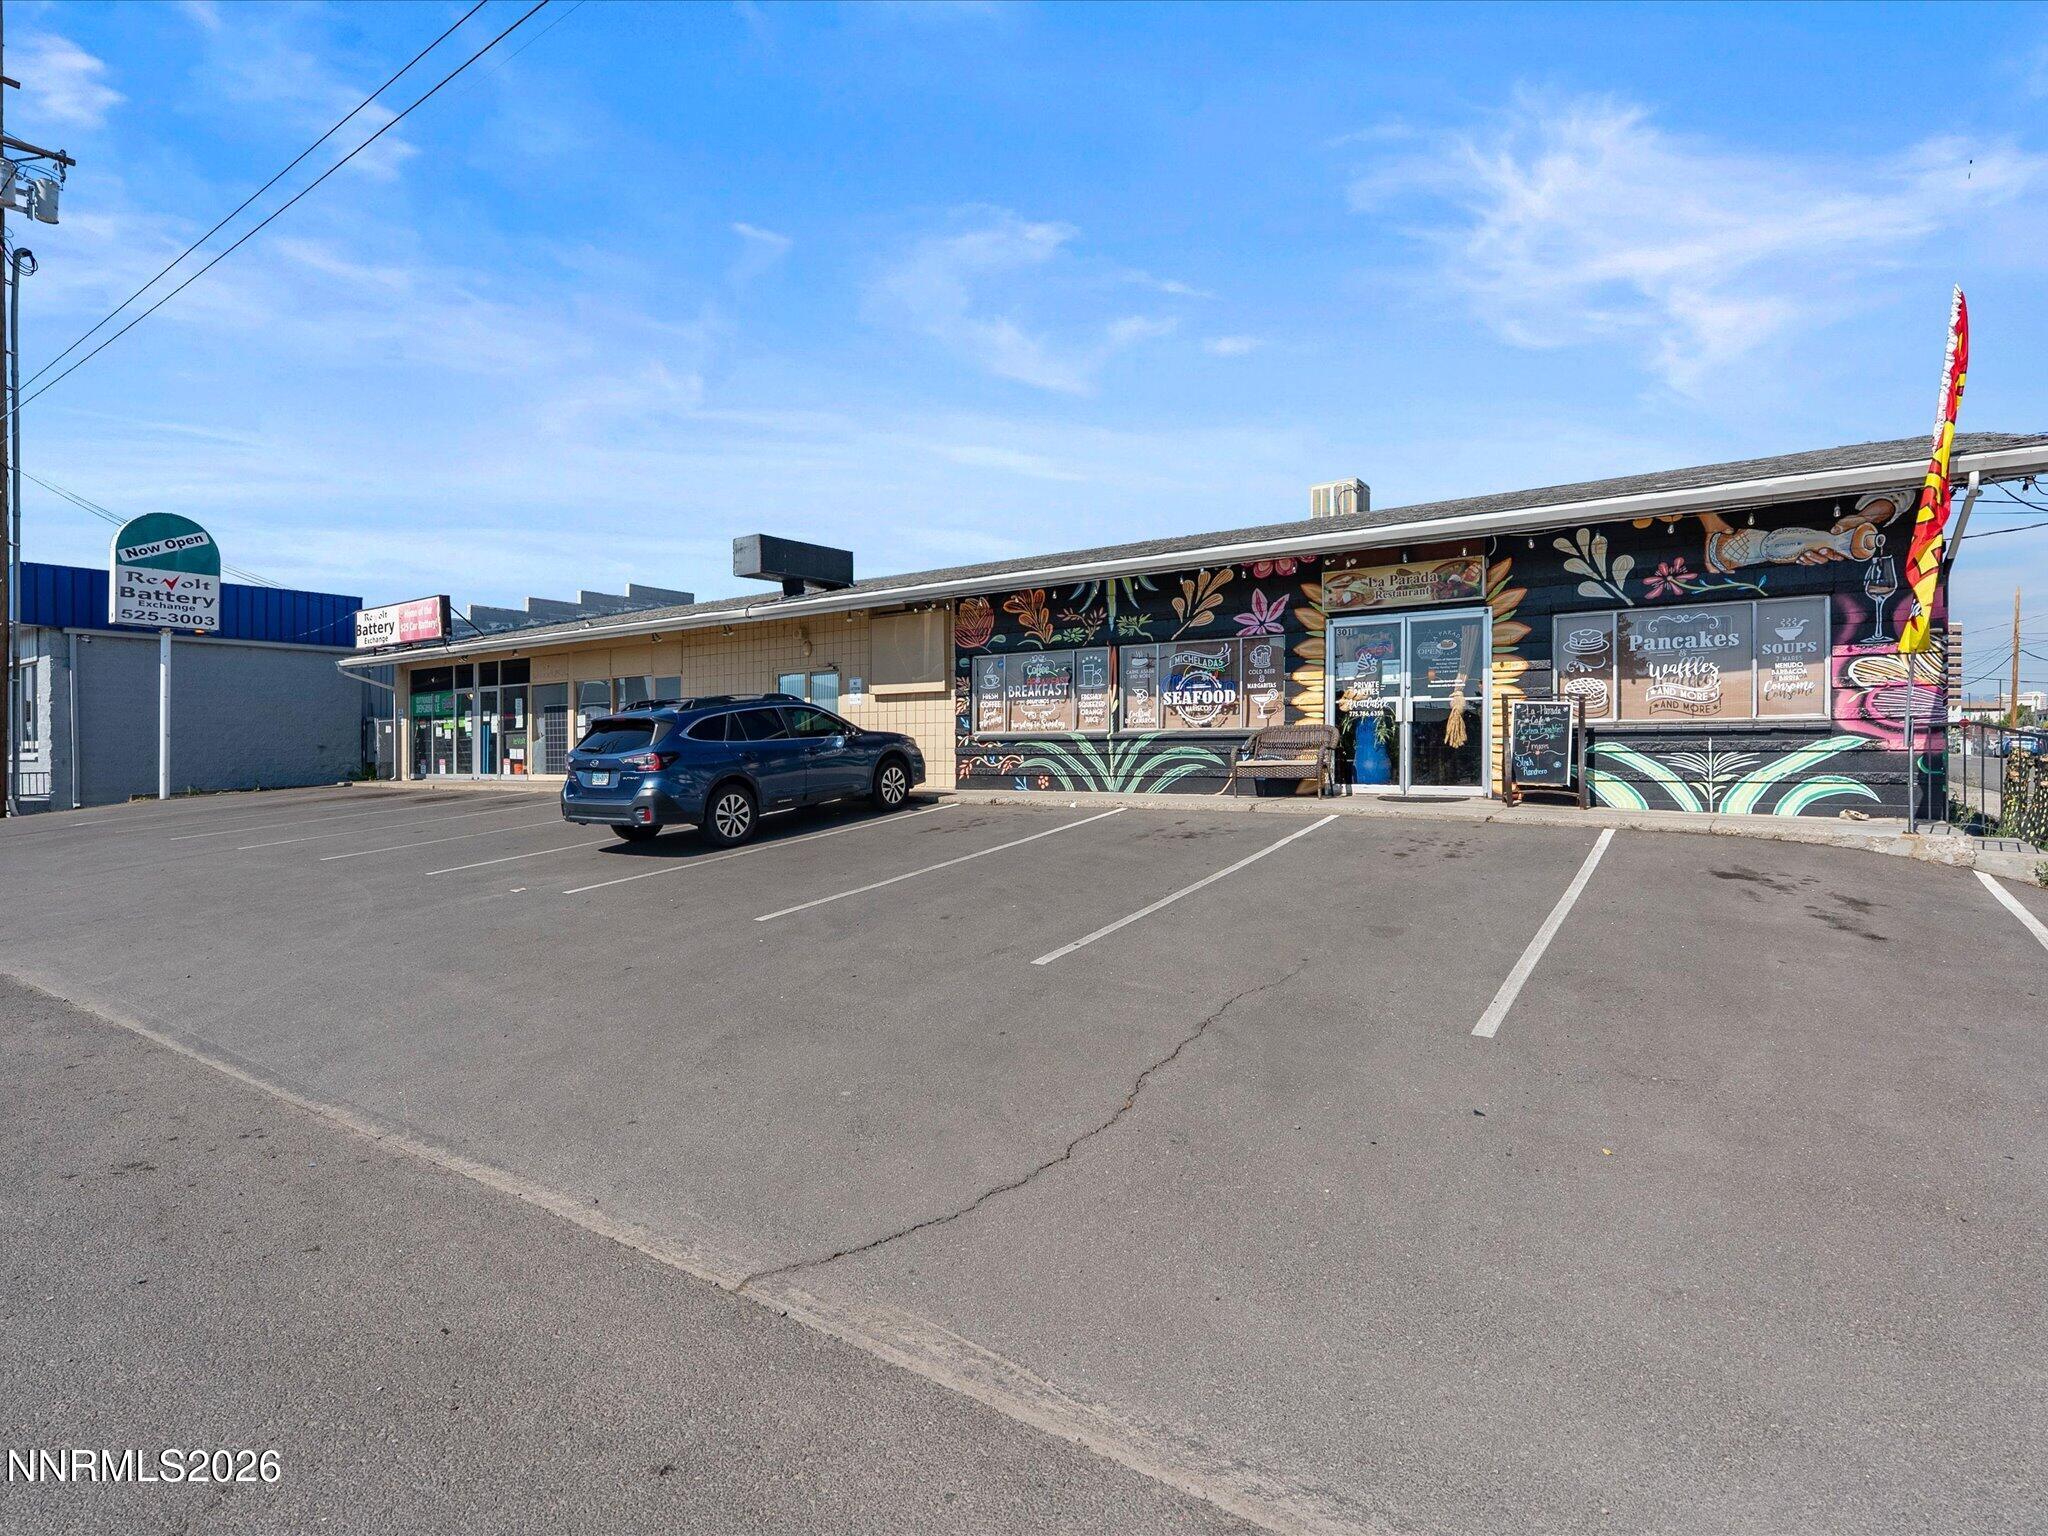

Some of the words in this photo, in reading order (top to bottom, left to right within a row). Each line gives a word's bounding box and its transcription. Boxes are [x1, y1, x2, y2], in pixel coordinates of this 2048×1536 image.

[125, 543, 160, 558] Now
[164, 535, 204, 550] Open
[1368, 577, 1385, 587] La
[1390, 572, 1437, 586] Parada
[120, 586, 215, 608] Battery
[1375, 587, 1430, 599] Restaurant
[138, 600, 196, 612] Exchange
[121, 609, 215, 626] 525-3003
[356, 621, 395, 636] Battery
[1336, 628, 1353, 637] 301
[364, 635, 389, 645] Exchange
[1628, 631, 1740, 651] Pancakes
[1678, 649, 1687, 657] &
[1761, 641, 1817, 655] SOUPS
[1174, 655, 1223, 667] MICHELADAS
[1026, 664, 1050, 676] Coffee
[1646, 656, 1720, 682] Waffles
[1771, 668, 1808, 676] BARBACOA
[1008, 683, 1069, 698] BREAKFAST
[1353, 681, 1380, 689] PRIVATE
[1163, 689, 1236, 705] SEAFOOD
[1353, 688, 1380, 696] PARTIES
[1657, 688, 1677, 696] AND
[1680, 691, 1709, 700] MORE
[1660, 700, 1680, 709] AND
[1683, 703, 1711, 713] MORE
